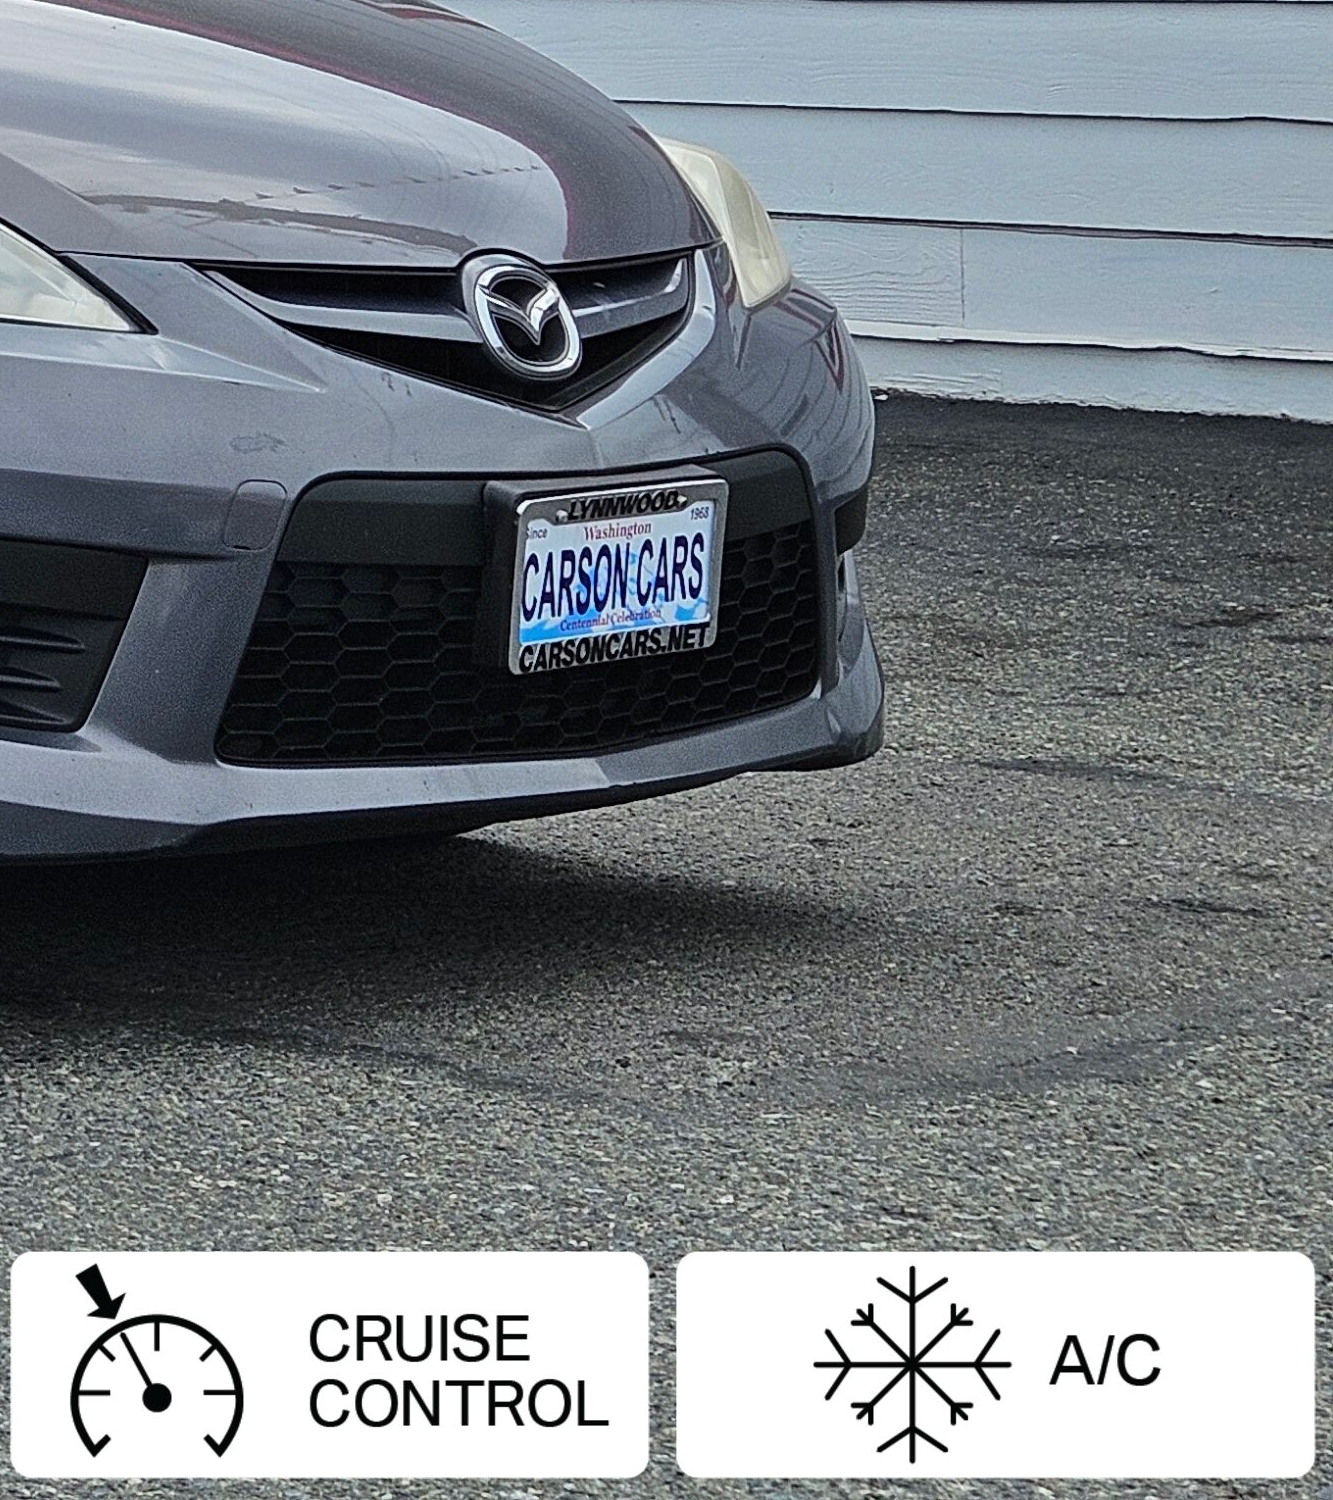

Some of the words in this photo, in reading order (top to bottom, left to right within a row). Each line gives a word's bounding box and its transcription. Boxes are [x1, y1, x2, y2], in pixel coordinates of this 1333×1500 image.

[584, 521, 652, 542] Washington
[521, 542, 630, 622] CARSON
[636, 531, 704, 607] CARS
[518, 624, 711, 673] CARSONCARS.NET
